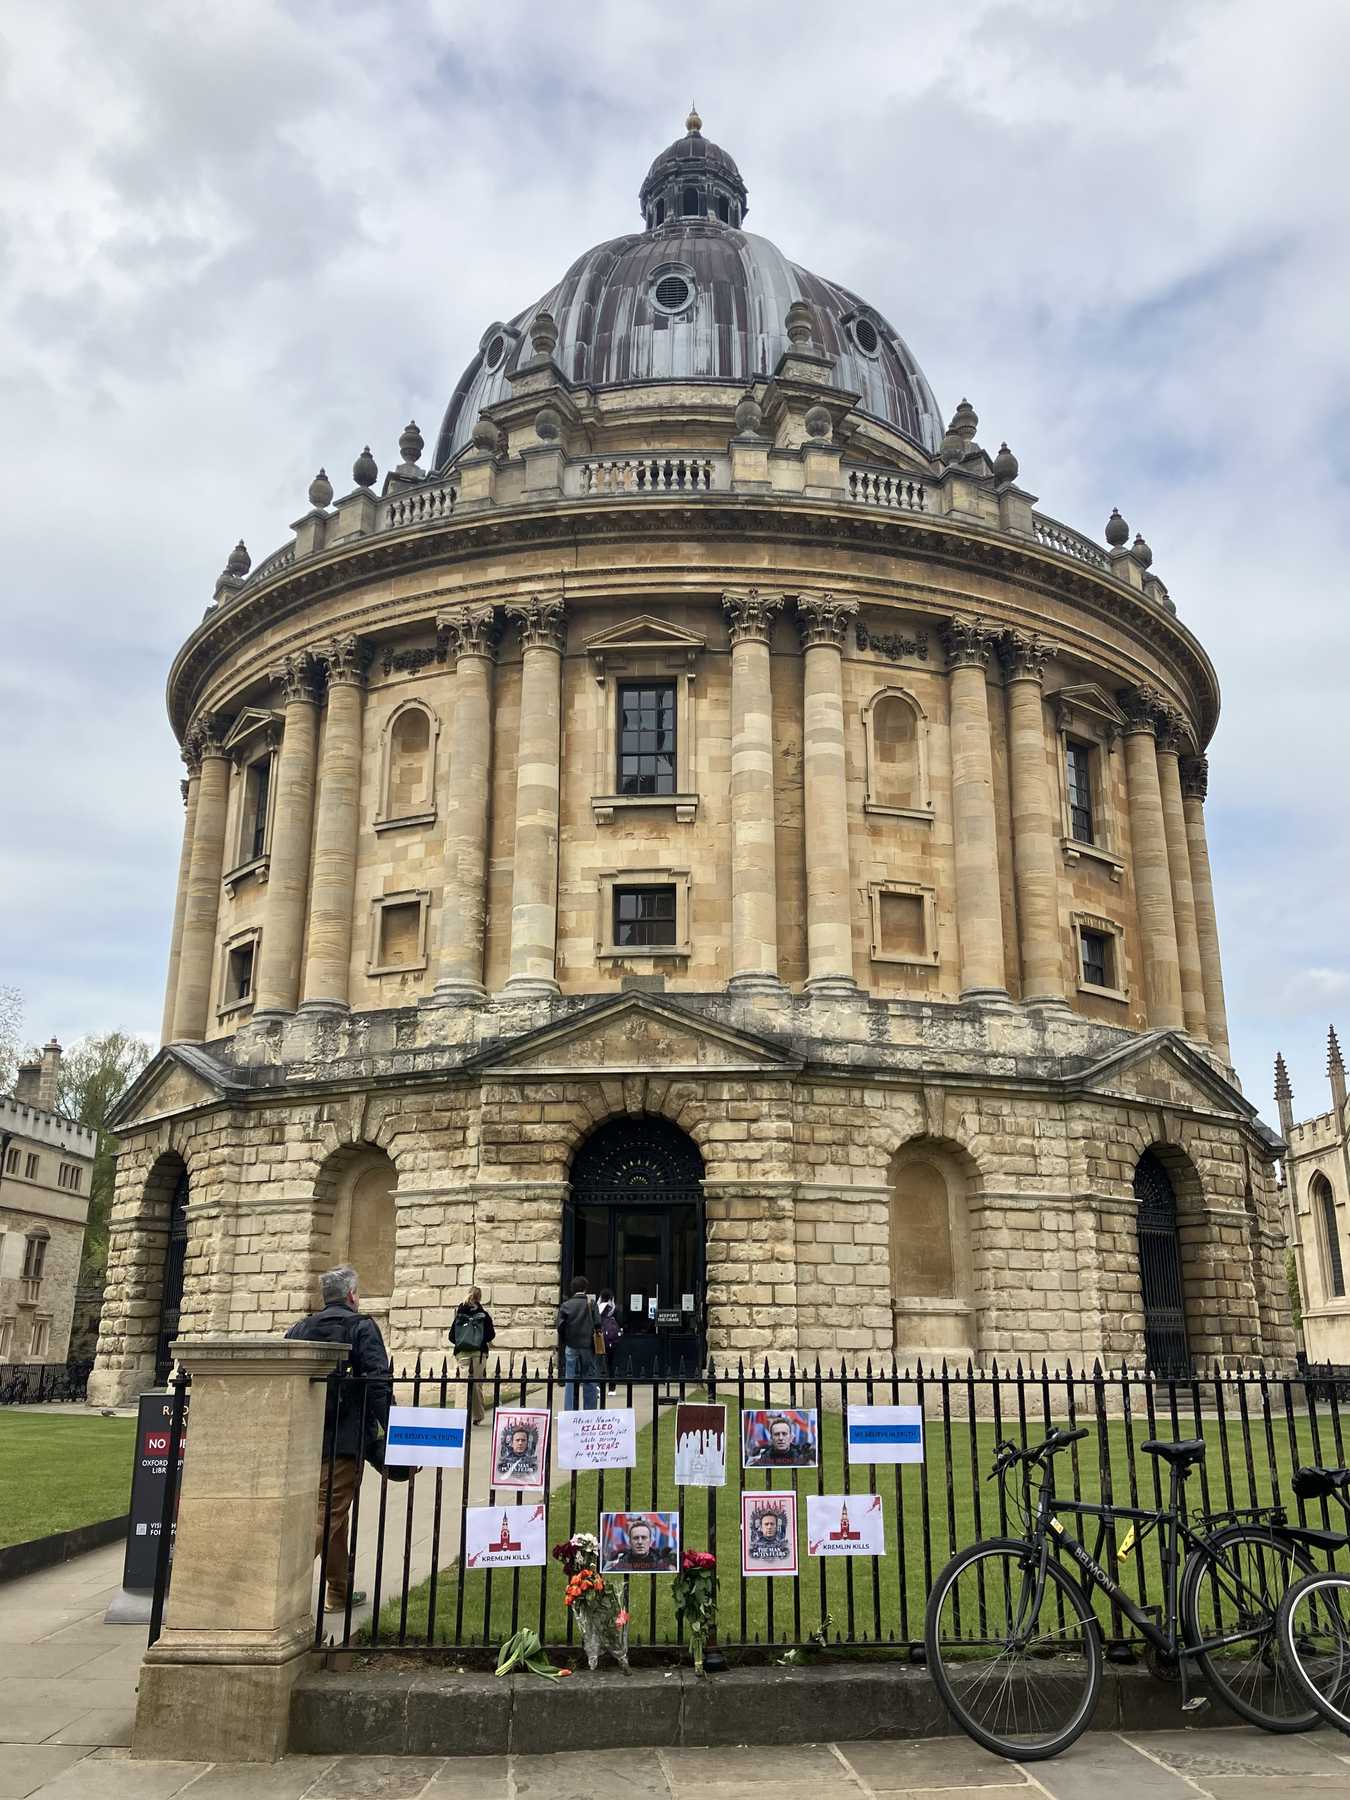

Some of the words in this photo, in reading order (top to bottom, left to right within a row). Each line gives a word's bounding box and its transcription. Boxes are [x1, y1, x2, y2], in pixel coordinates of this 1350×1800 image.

[581, 1423, 613, 1432] KILLED
[148, 1439, 167, 1449] NO
[597, 1441, 620, 1450] YEARS
[142, 1459, 168, 1467] OXFORD
[482, 1554, 512, 1562] KREMLIN
[1074, 1546, 1117, 1592] BELMONT
